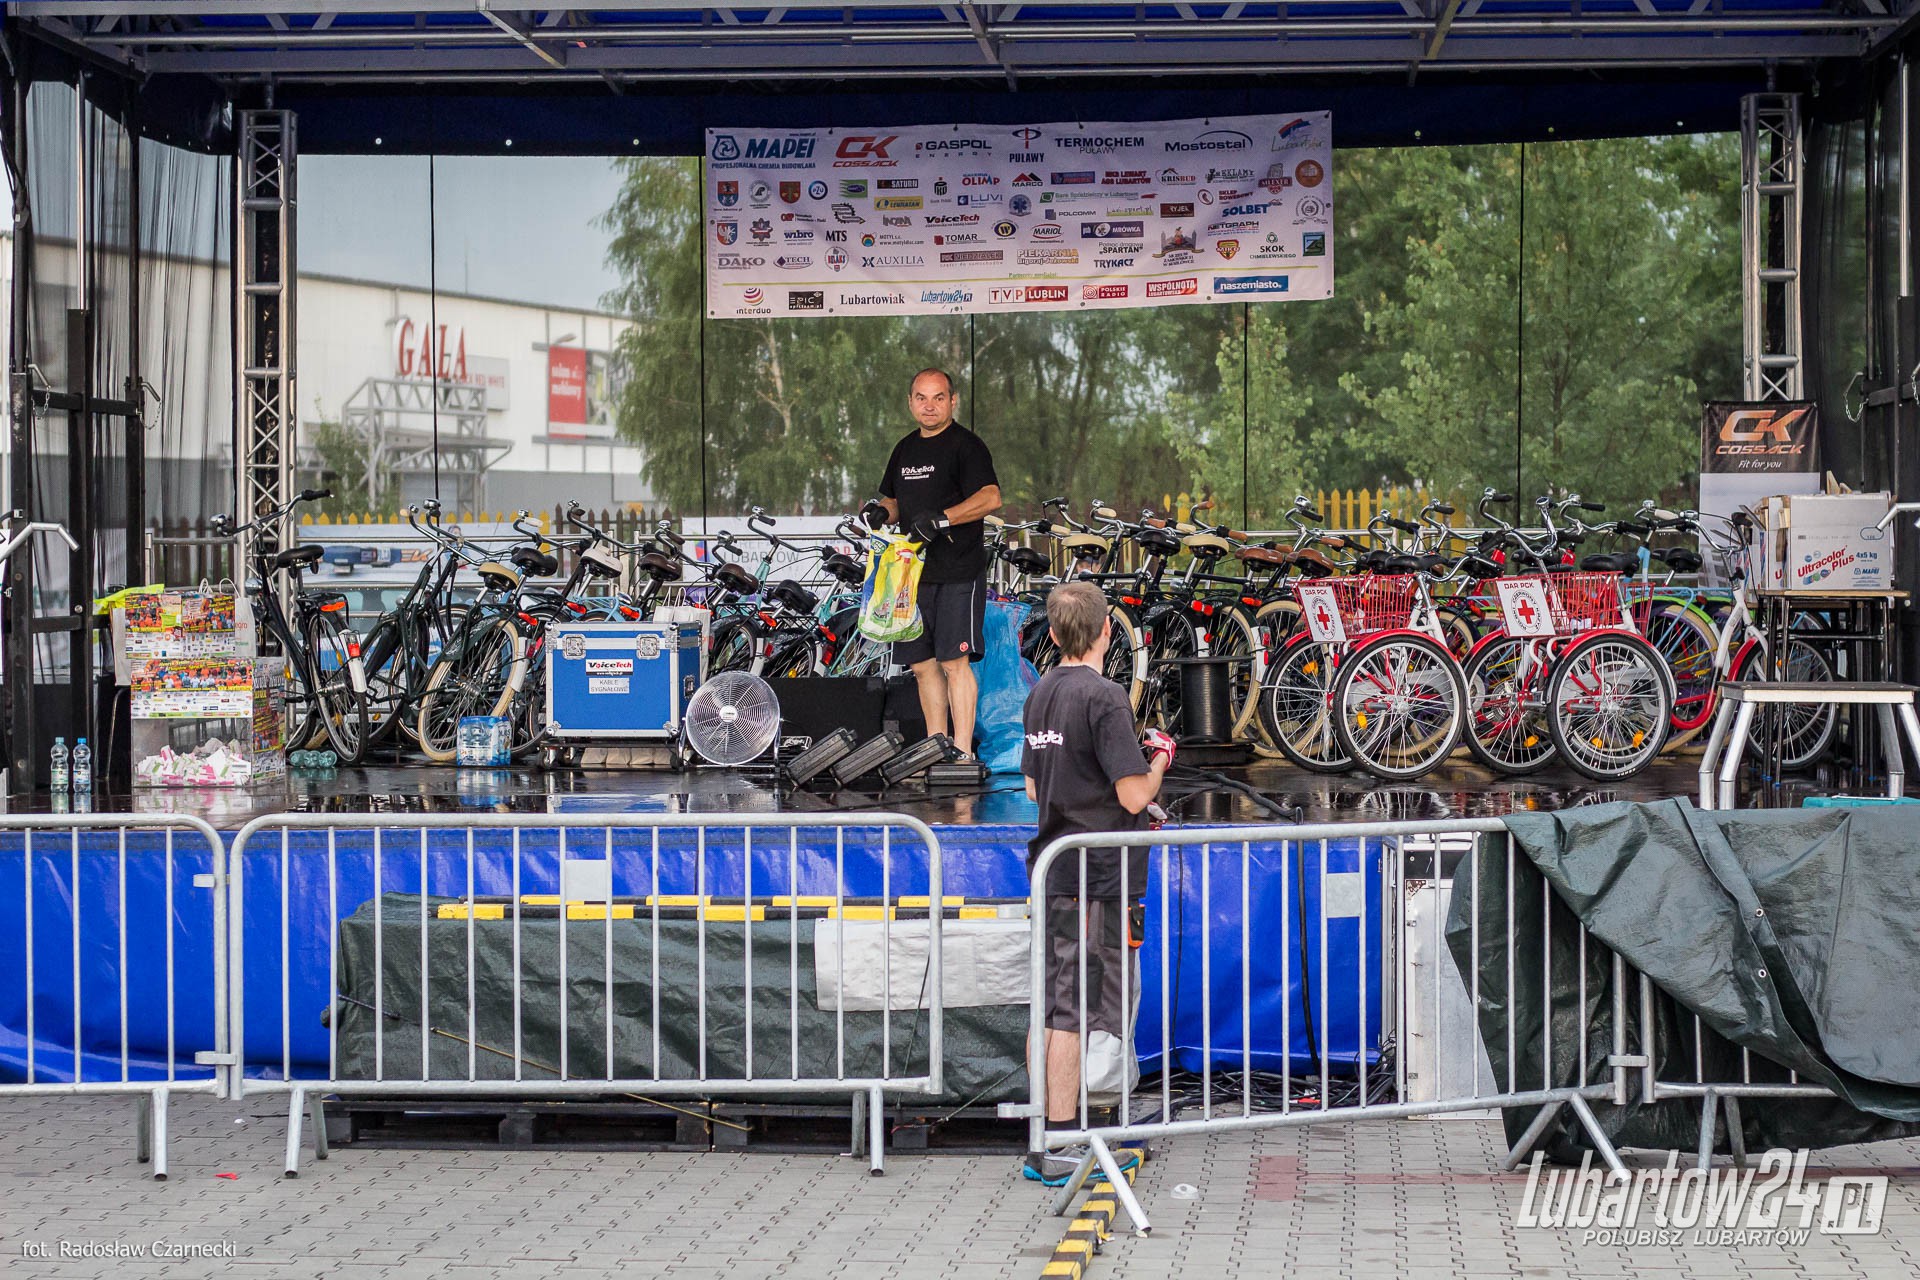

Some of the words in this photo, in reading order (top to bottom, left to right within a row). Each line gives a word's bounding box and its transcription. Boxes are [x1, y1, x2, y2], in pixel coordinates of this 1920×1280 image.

[835, 135, 900, 159] CK
[925, 139, 992, 151] GASPOL
[1054, 137, 1145, 148] TERMOCHEM
[1164, 139, 1246, 152] Mostostal
[745, 138, 816, 159] MAPEI
[1009, 152, 1045, 163] PUŁAWY
[832, 160, 900, 168] COSSACK
[891, 179, 919, 189] SATURN
[962, 176, 1001, 187] OLIMP
[970, 194, 1003, 202] LUVI
[1222, 204, 1271, 217] SOLBET
[924, 214, 981, 224] VoiceTech
[1032, 225, 1063, 236] MARIOL
[1207, 220, 1260, 231] NETGRAPH
[784, 230, 814, 239] wibro
[825, 230, 848, 243] MTS
[945, 233, 978, 241] TOMAR
[1017, 249, 1079, 257] PIEKARNIA
[1259, 245, 1285, 253] SKOK
[877, 256, 925, 265] AUXILIA
[1249, 252, 1297, 260] CHMIELEWSKIEGO
[718, 257, 766, 267] DAKO
[1094, 258, 1134, 269] TRYKACZ
[1148, 279, 1196, 292] WSPÓLNOTA
[840, 293, 905, 305] Lubartowiak
[1028, 289, 1066, 300] LUBLIN
[789, 296, 815, 305] EPIC
[736, 307, 772, 315] interduo
[397, 319, 467, 380] GALA
[1719, 408, 1811, 442] CK
[1715, 444, 1806, 455] COSSACK
[1738, 459, 1750, 469] Fit
[1751, 458, 1764, 470] for
[1764, 460, 1782, 470] you
[1797, 545, 1848, 577] Ultracolor
[1869, 552, 1878, 560] kg
[1831, 555, 1855, 571] Plus
[1862, 567, 1880, 575] MAPEI
